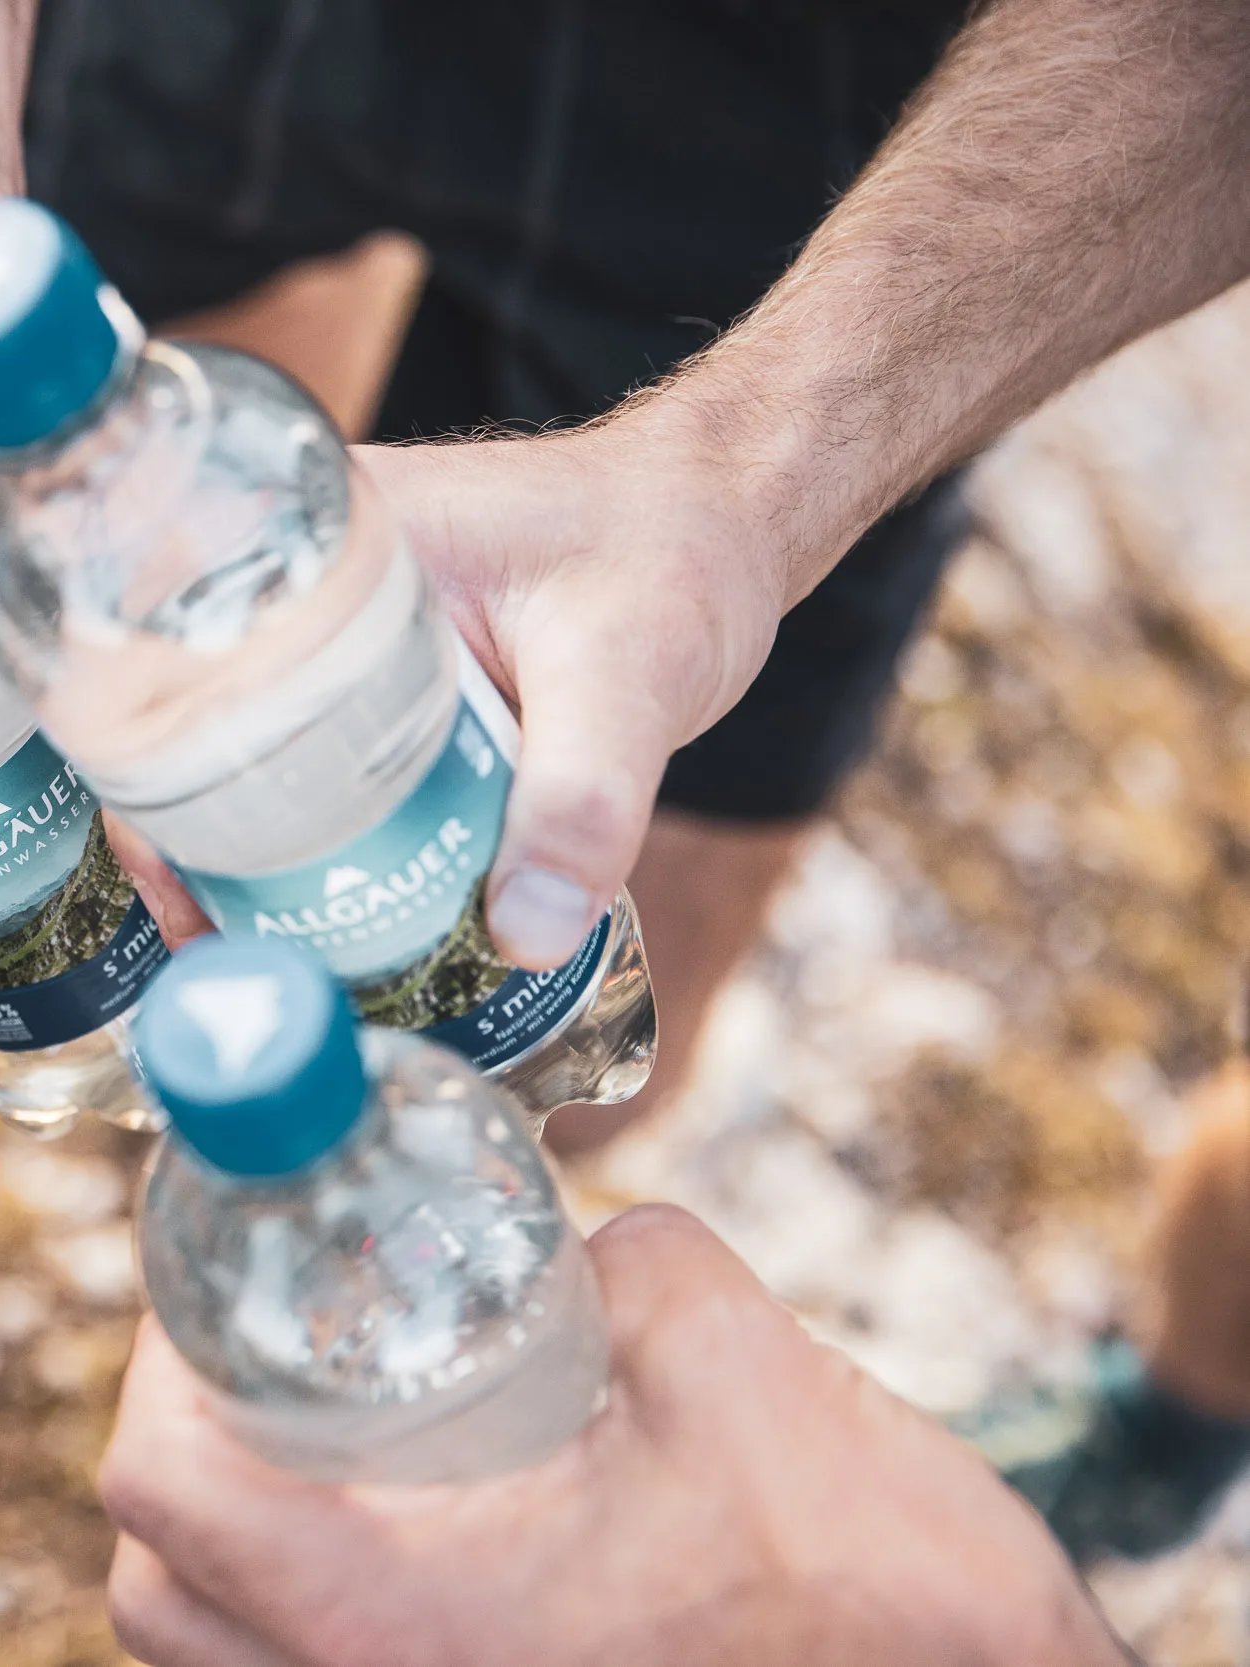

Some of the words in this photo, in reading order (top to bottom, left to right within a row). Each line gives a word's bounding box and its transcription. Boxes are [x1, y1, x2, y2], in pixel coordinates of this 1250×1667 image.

[472, 1036, 518, 1065] medium
[526, 1015, 546, 1034] mit
[546, 986, 573, 1016] wenig
